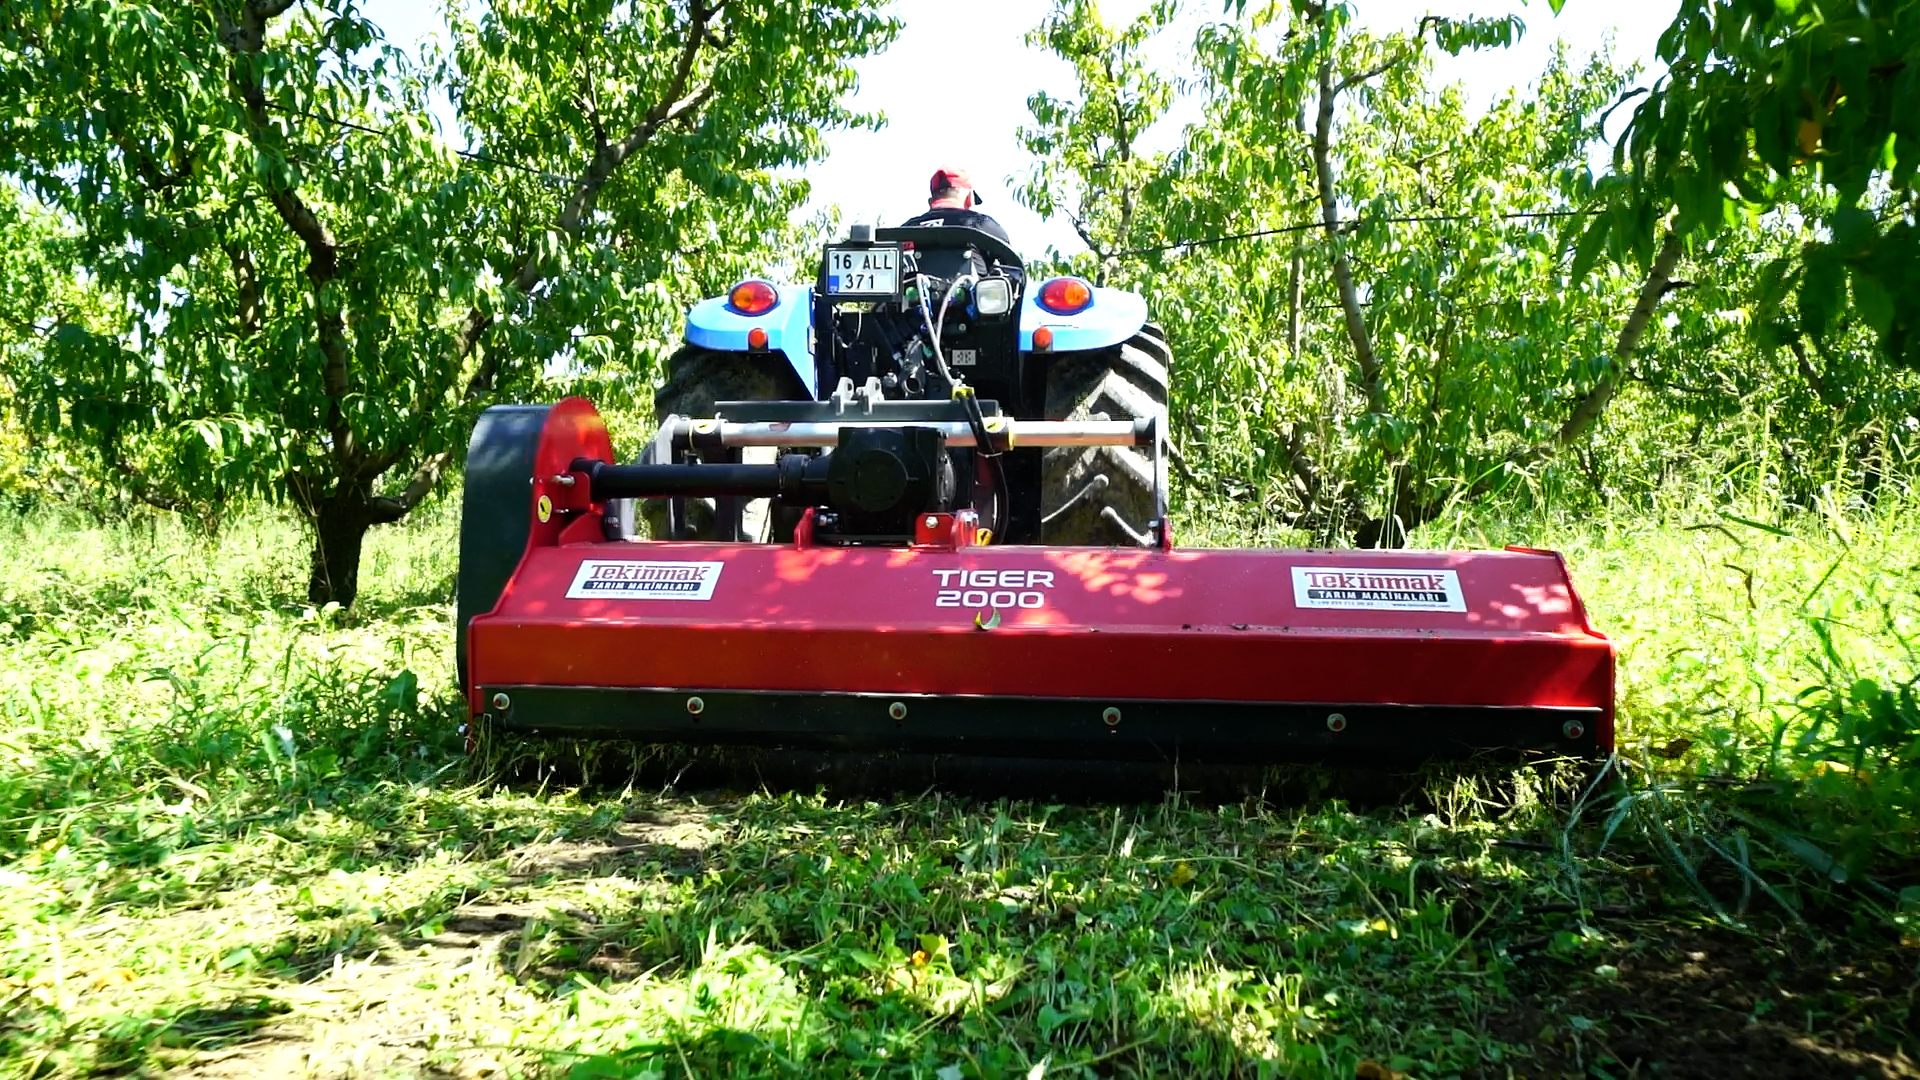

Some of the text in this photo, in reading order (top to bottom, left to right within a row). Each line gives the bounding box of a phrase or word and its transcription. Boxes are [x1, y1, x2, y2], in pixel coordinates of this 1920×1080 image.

[833, 254, 893, 270] 16 ALL
[845, 273, 875, 290] 371
[589, 564, 712, 581] Tekinmak
[932, 569, 1055, 588] TIGER
[592, 581, 625, 590] TARIM
[1304, 572, 1447, 591] Tekinmak
[935, 590, 1045, 609] 2000
[1318, 590, 1357, 600] TARIM
